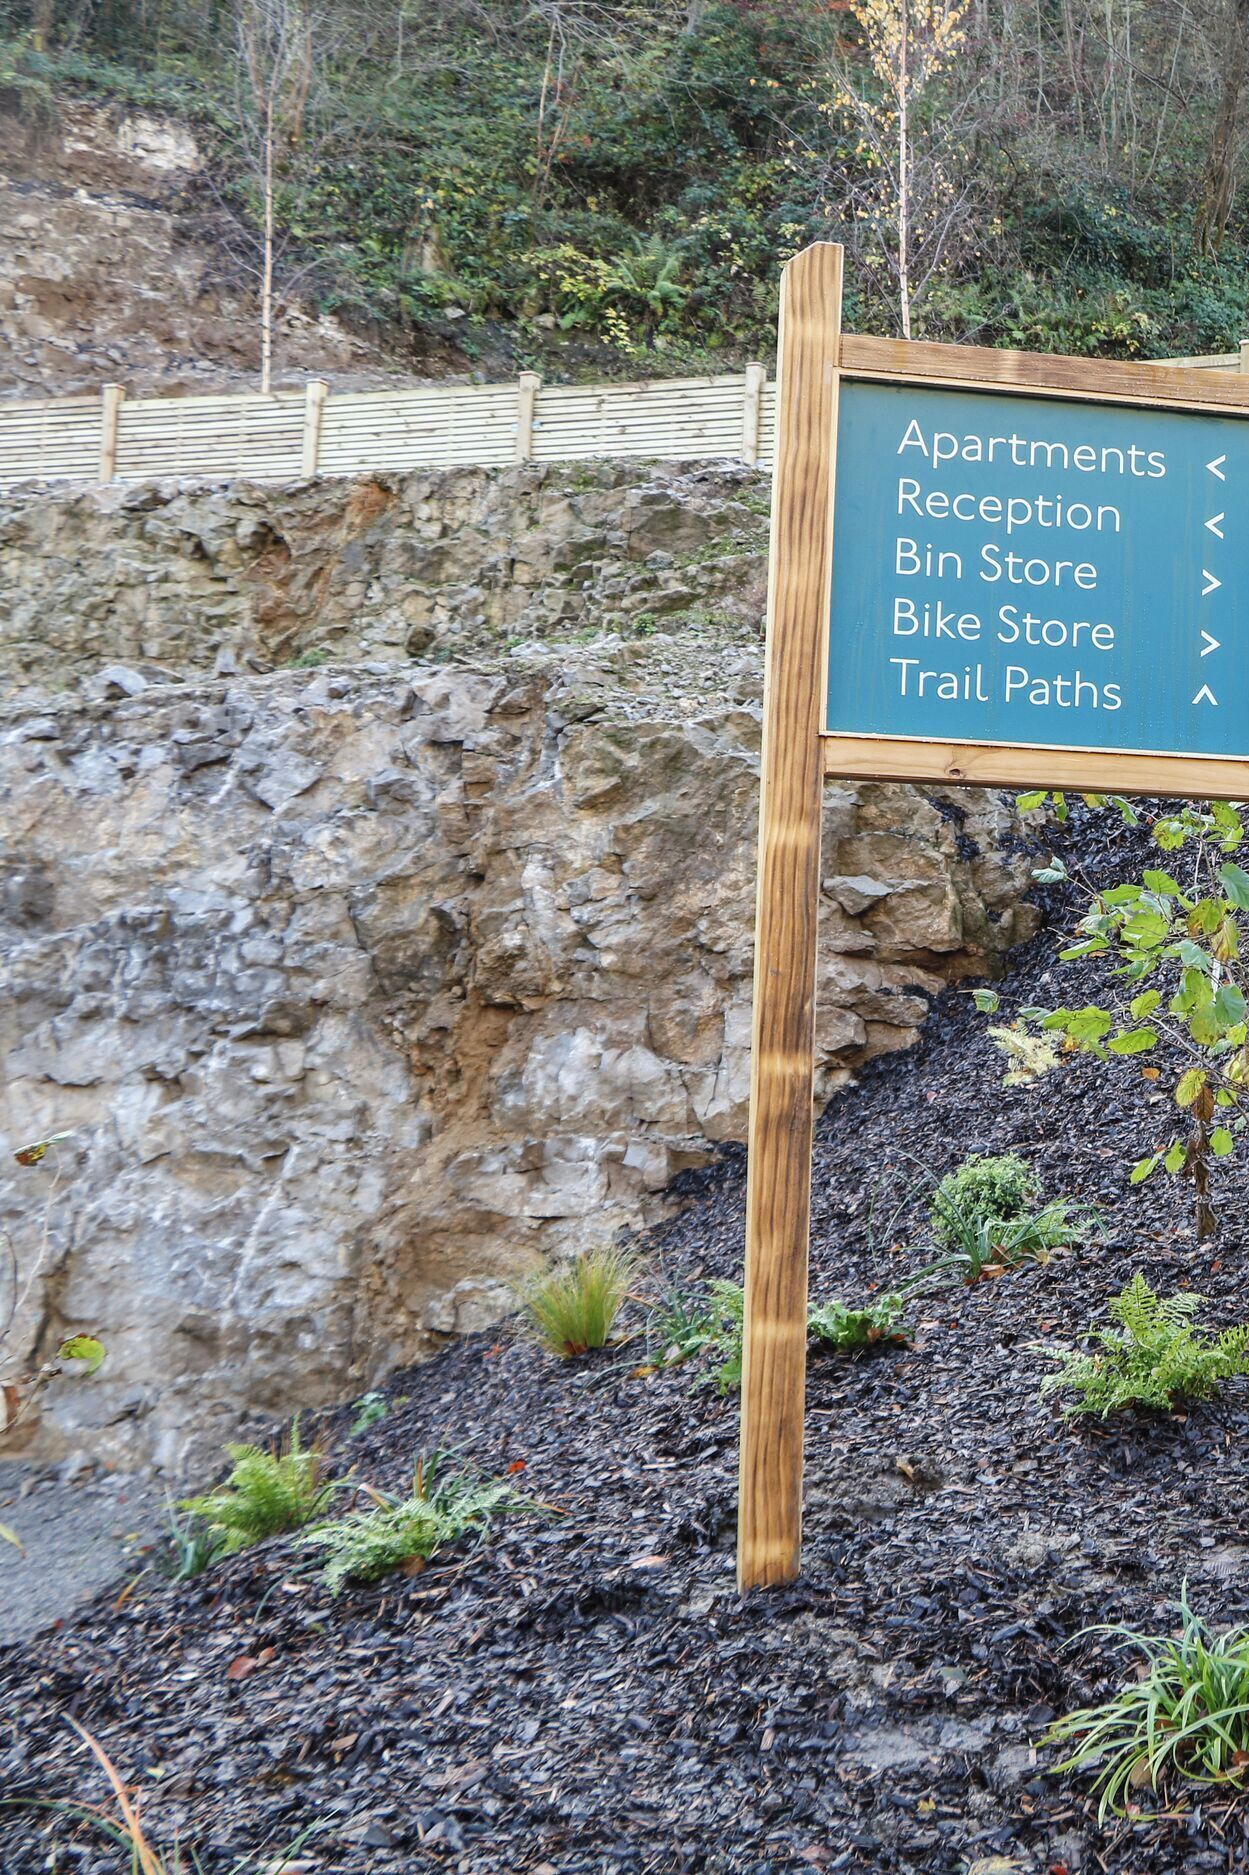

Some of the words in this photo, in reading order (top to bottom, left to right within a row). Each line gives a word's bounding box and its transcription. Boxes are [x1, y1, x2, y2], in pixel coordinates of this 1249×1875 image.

[896, 417, 1168, 479] Apartments
[896, 477, 1121, 534] Reception
[895, 537, 963, 580] Bin
[979, 543, 1098, 590] Store
[892, 597, 982, 641] Bike
[996, 604, 1116, 651] Store
[889, 657, 989, 703] Trail
[1004, 665, 1123, 711] Paths
